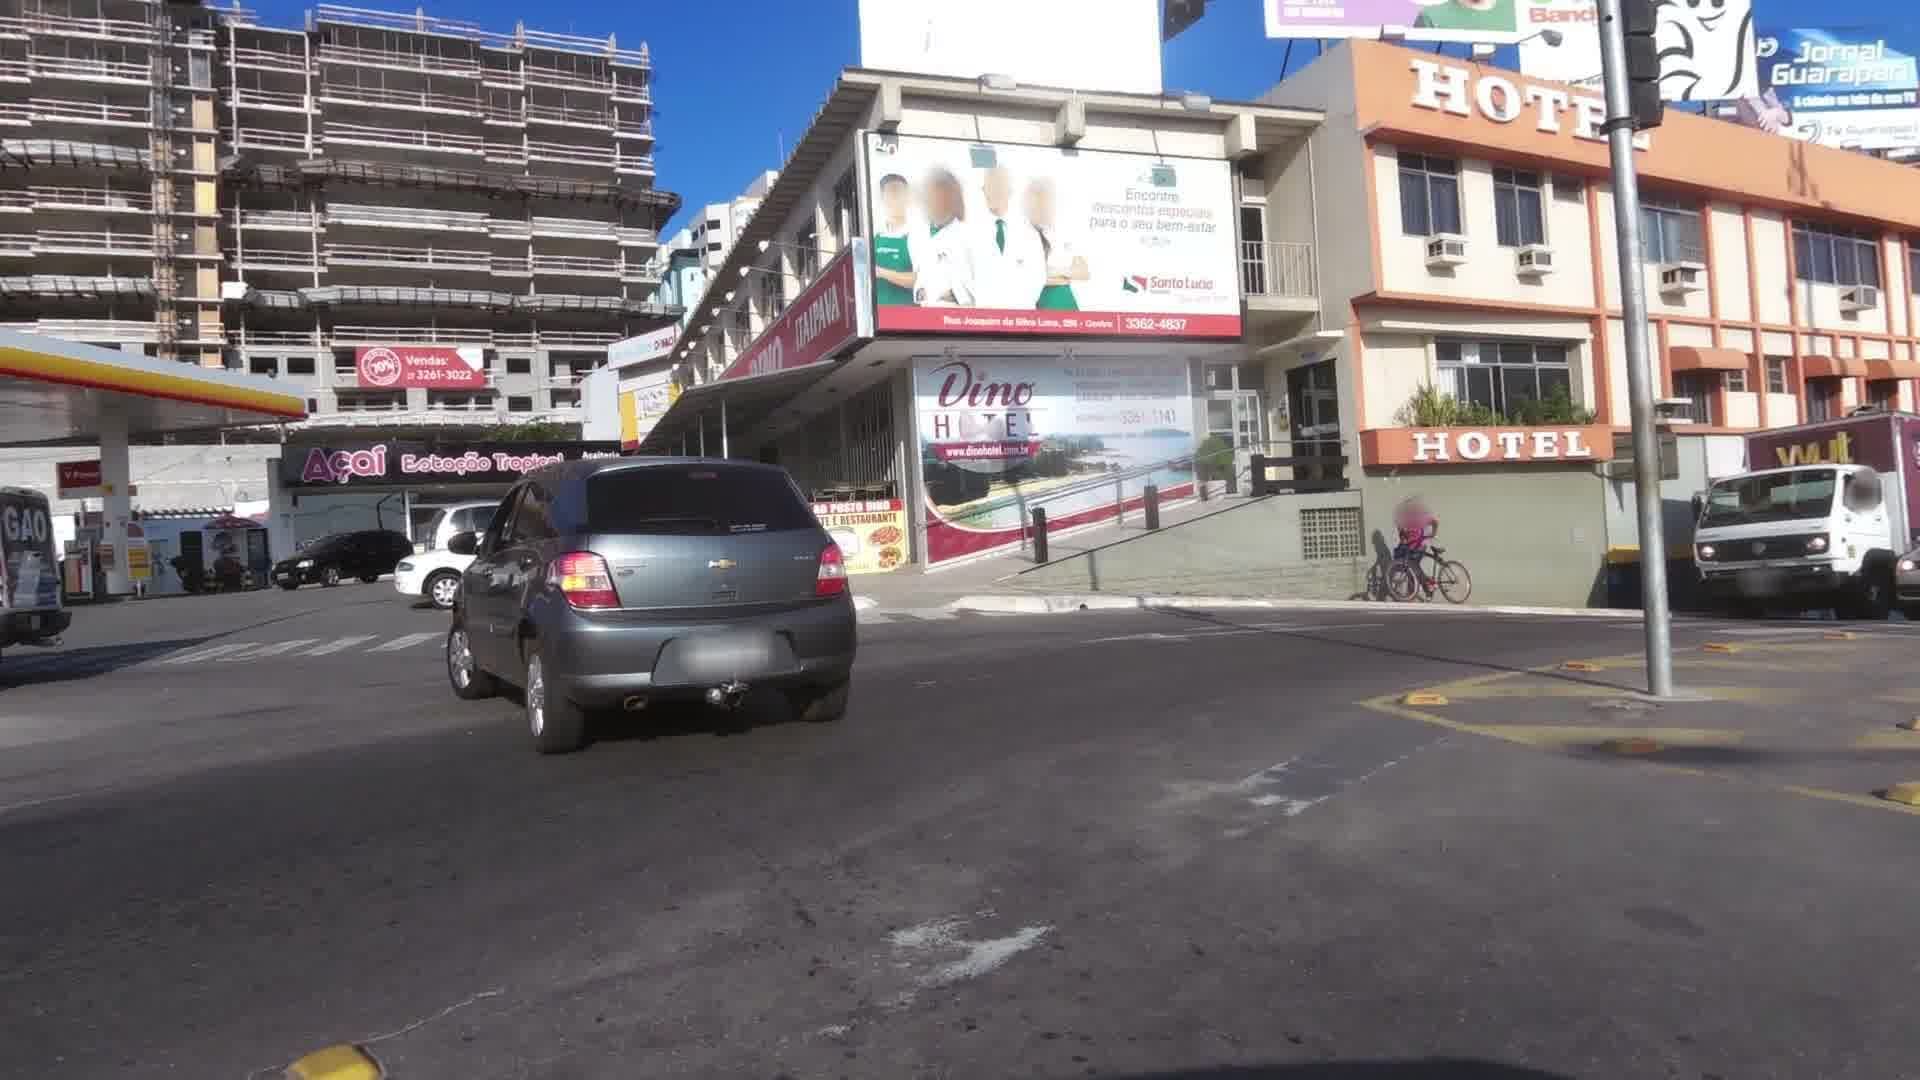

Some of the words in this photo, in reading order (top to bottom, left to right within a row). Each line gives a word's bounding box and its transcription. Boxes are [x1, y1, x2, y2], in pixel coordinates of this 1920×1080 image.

[1793, 39, 1885, 63] Jornal
[1408, 57, 1651, 152] HOTE
[1125, 188, 1180, 203] Encontre
[794, 280, 841, 353] ITAIPAVA
[1125, 317, 1187, 331] 3362-4837
[416, 369, 473, 381] 3261-3022
[928, 361, 1036, 408] Dino
[934, 412, 1040, 440] HTEL
[1412, 430, 1592, 462] HOTEL
[840, 512, 897, 526] RESTAURANTE
